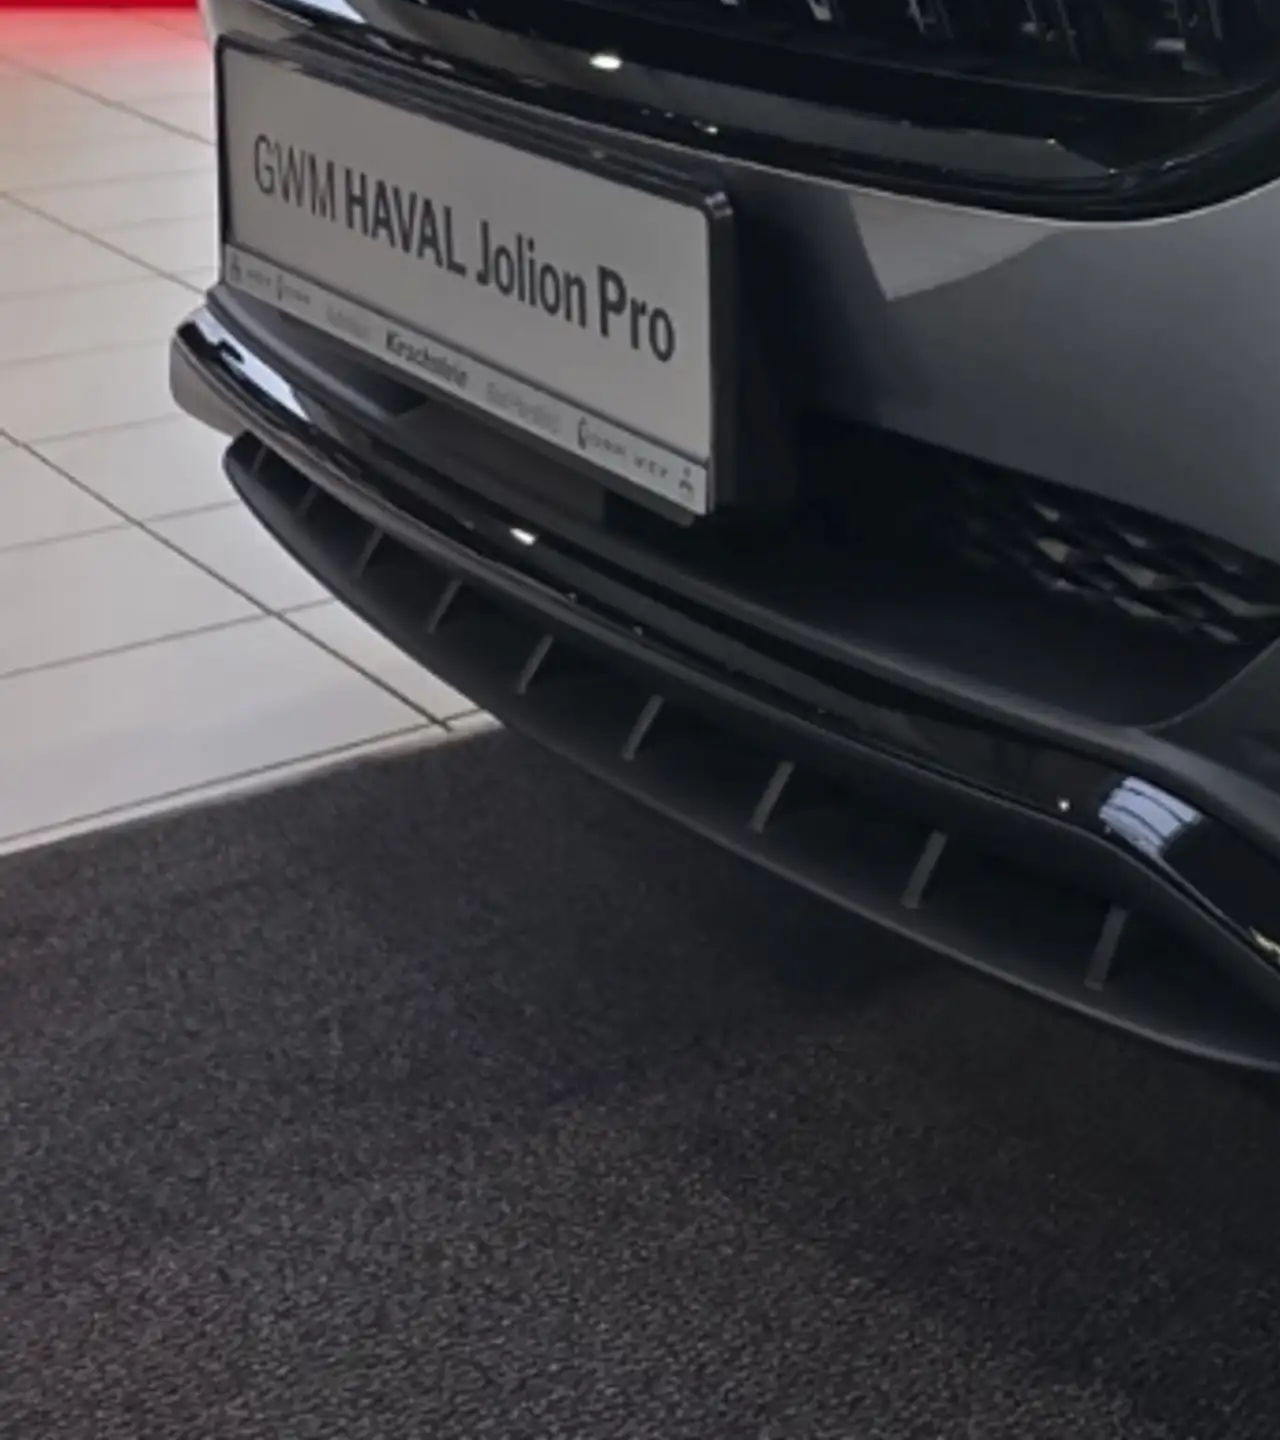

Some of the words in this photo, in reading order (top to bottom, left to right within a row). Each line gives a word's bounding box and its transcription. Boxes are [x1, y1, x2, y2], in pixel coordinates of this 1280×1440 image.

[251, 132, 338, 224] GWM
[343, 166, 468, 278] HAVAL
[477, 220, 588, 328] Jolion
[597, 264, 677, 363] Pro
